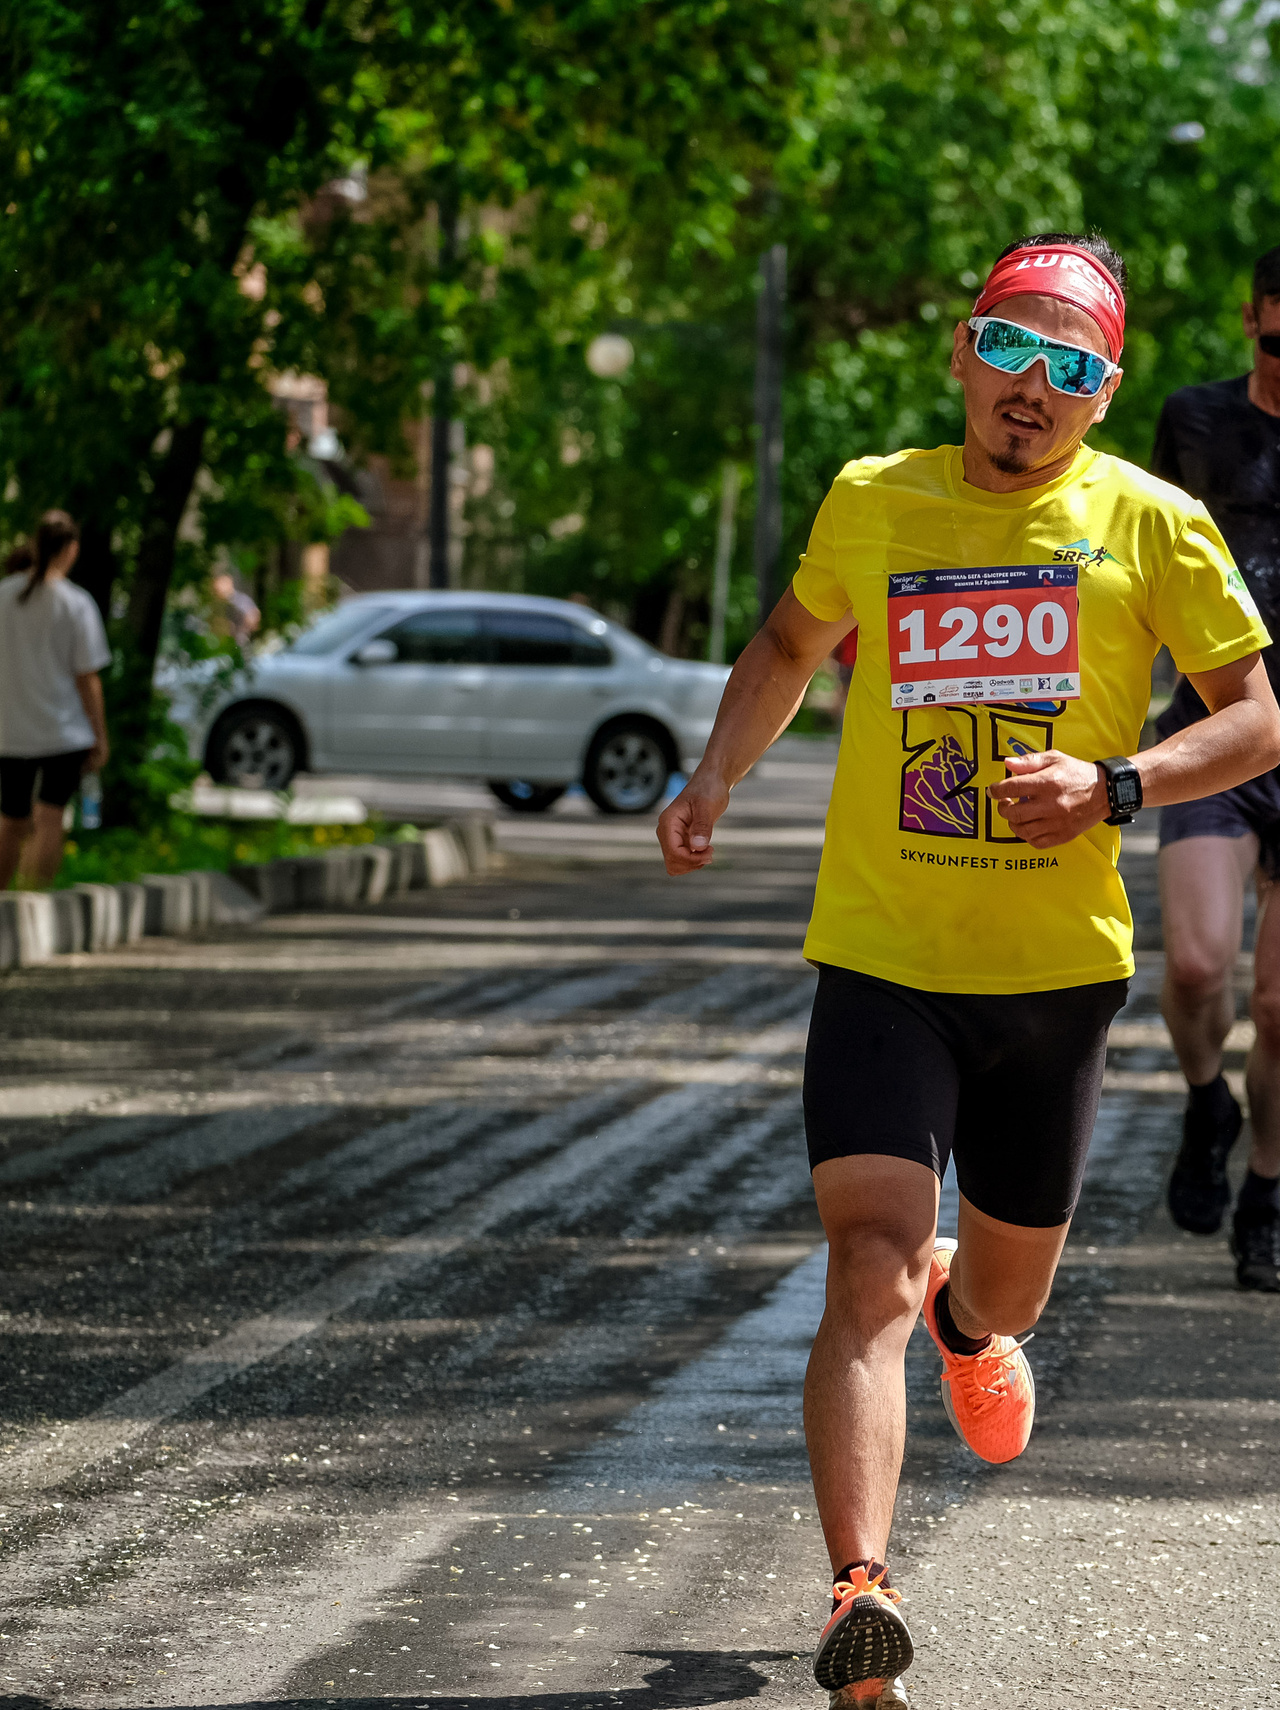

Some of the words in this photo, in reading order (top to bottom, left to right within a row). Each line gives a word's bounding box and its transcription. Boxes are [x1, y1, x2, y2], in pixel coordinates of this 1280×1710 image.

[1052, 549, 1088, 564] SRF
[898, 601, 1069, 665] 1290
[900, 848, 999, 870] SKYRUNFEST
[1004, 857, 1059, 870] SIBERIA
